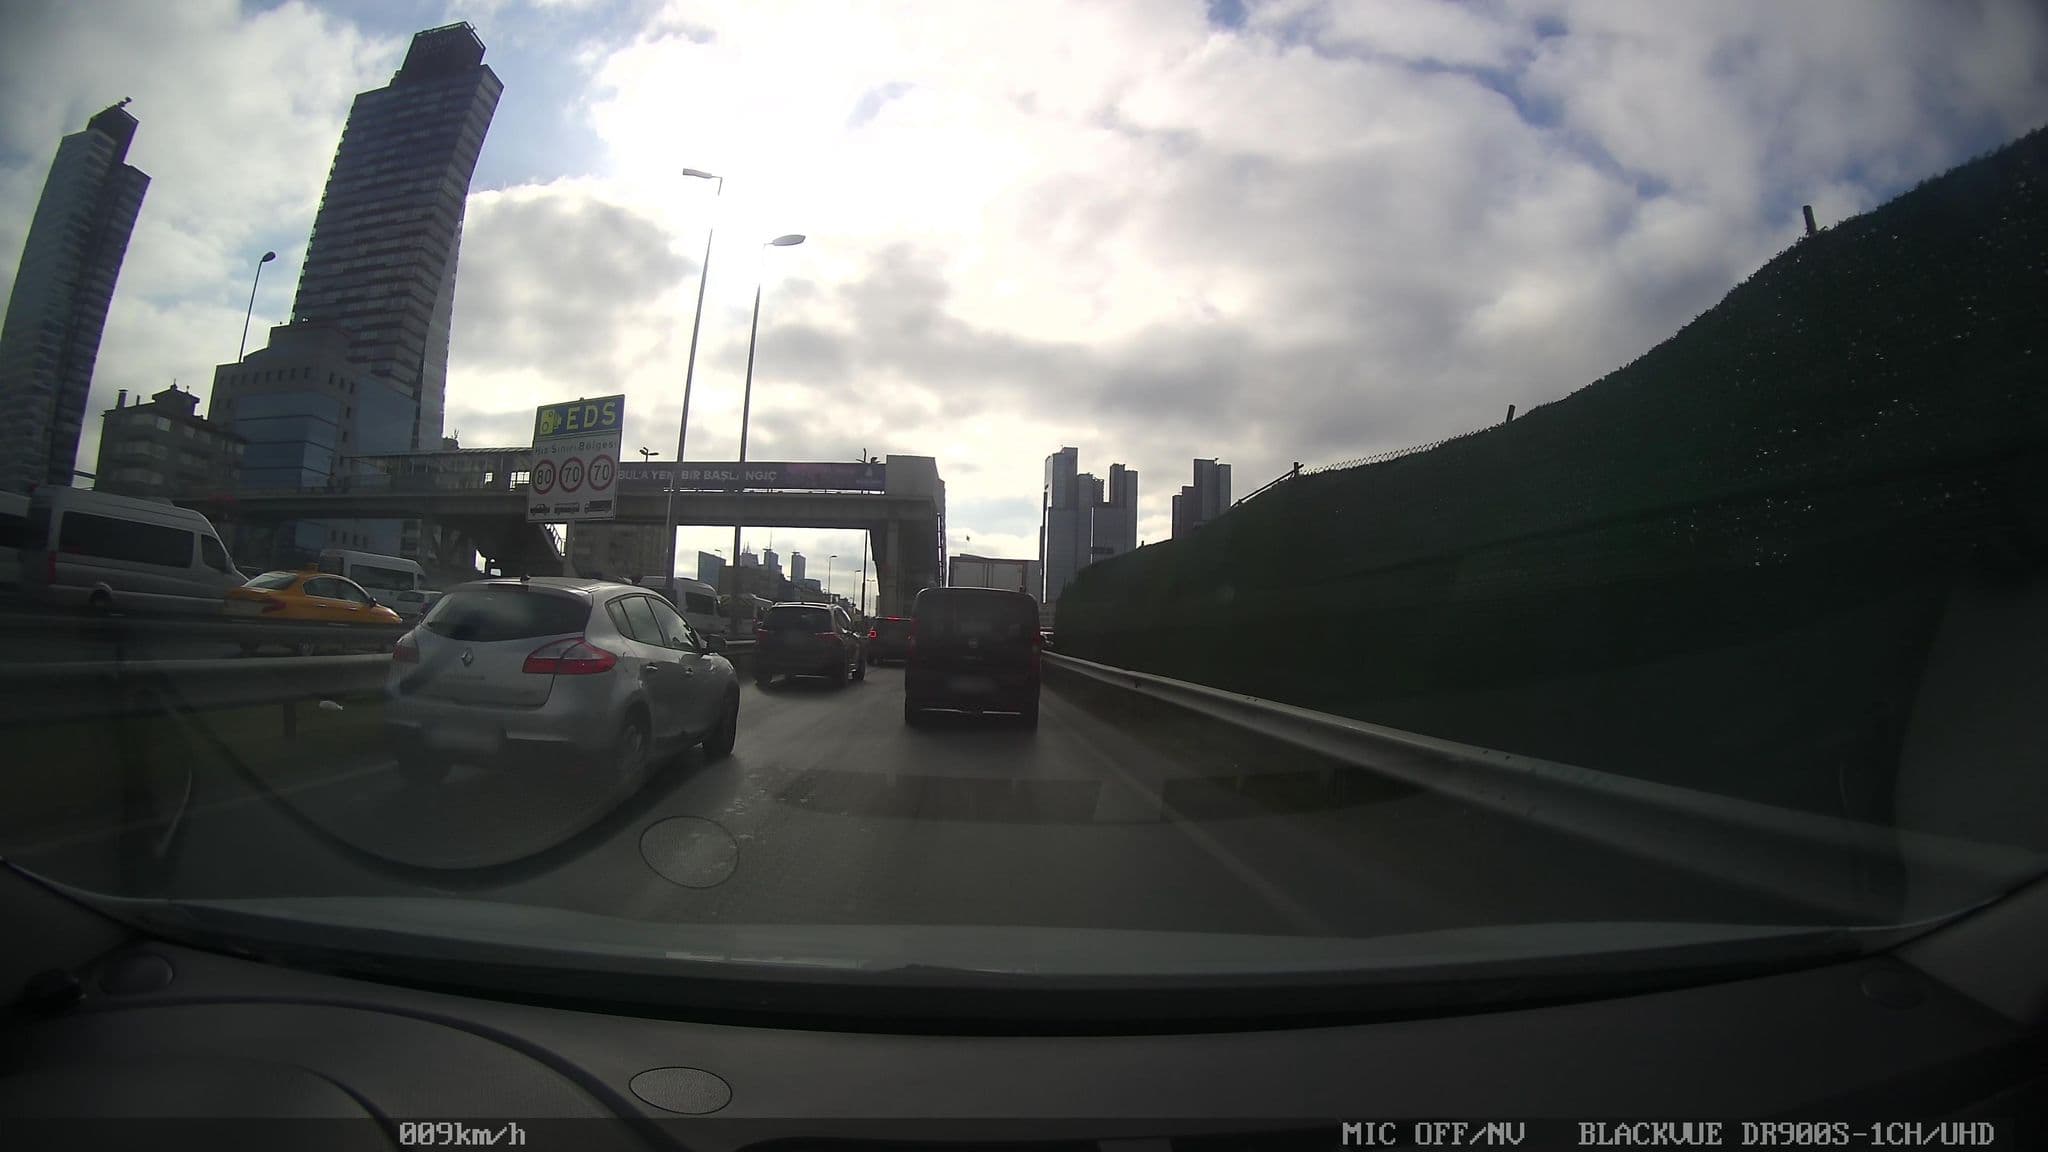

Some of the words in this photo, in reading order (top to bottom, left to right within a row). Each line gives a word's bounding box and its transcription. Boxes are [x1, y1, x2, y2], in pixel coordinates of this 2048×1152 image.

[567, 402, 616, 430] EDS
[536, 469, 552, 485] 80
[565, 466, 580, 482] 70
[594, 464, 609, 480] 70
